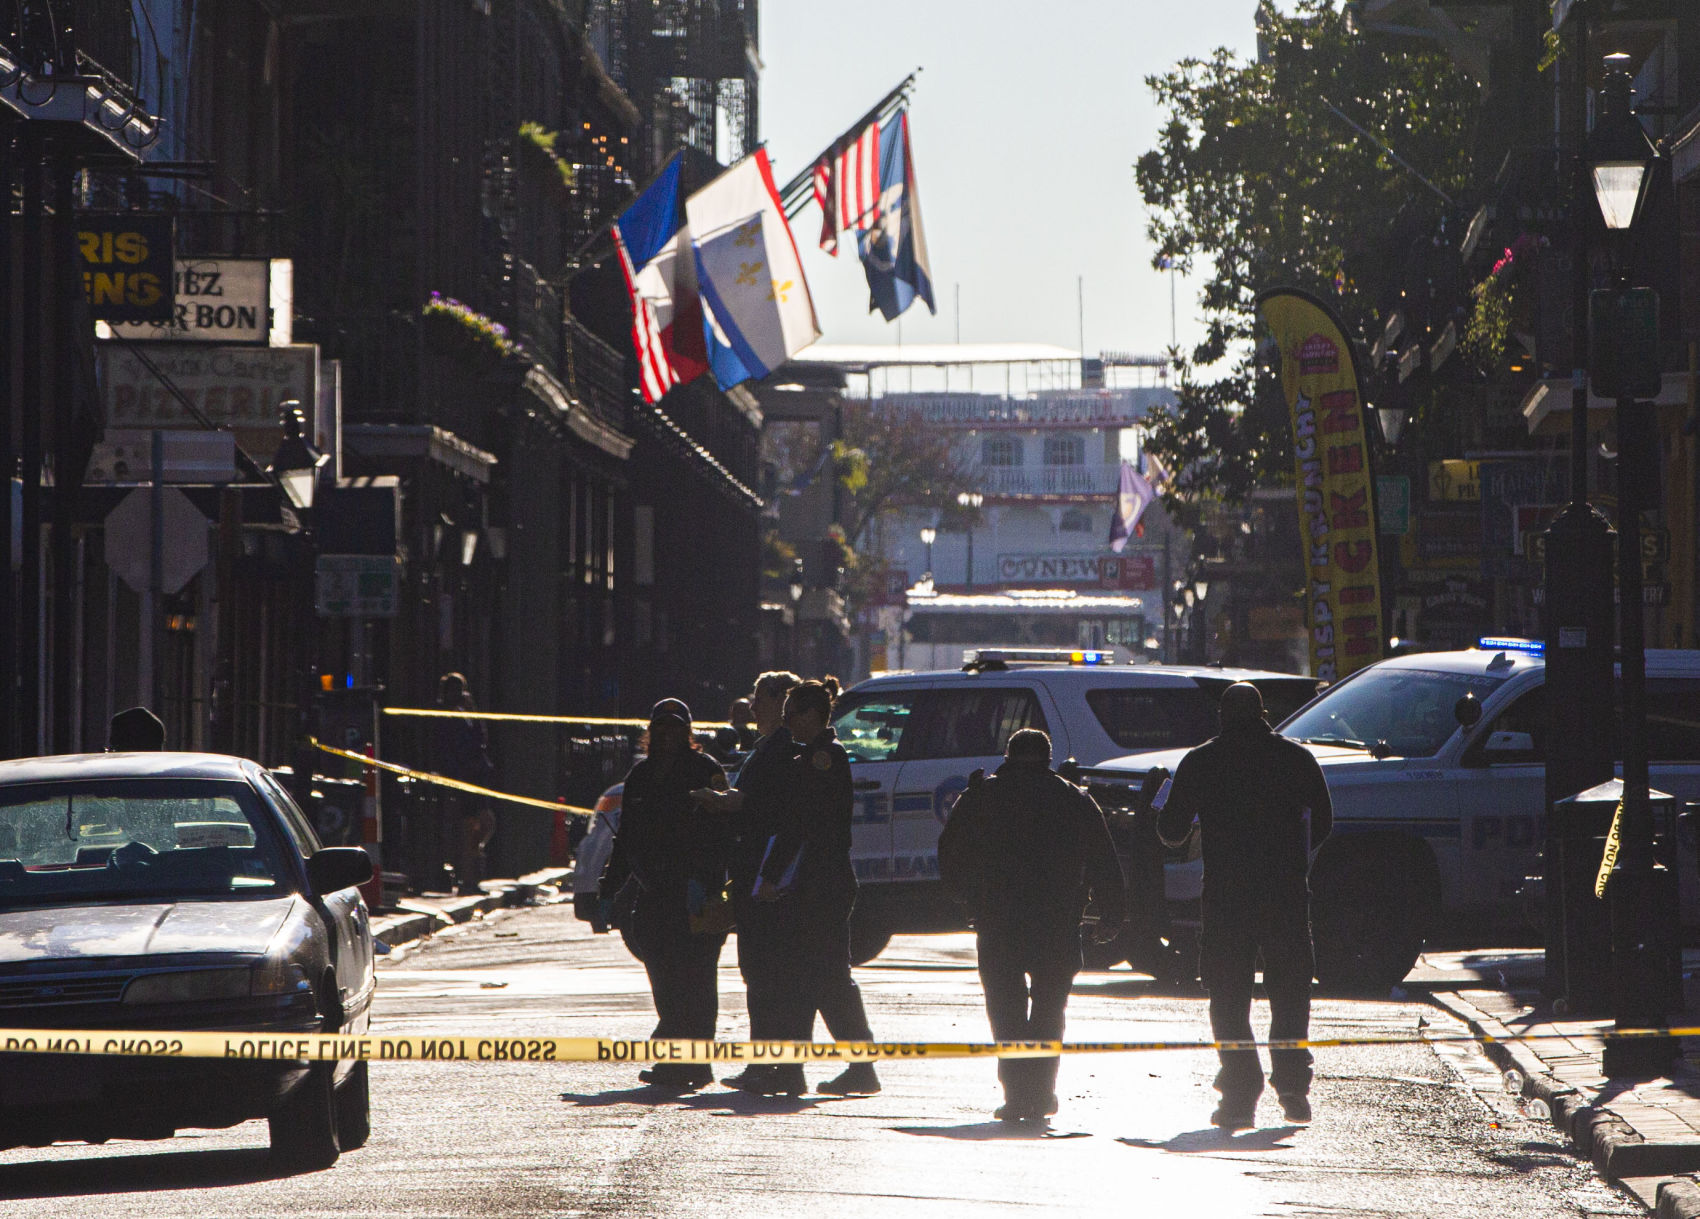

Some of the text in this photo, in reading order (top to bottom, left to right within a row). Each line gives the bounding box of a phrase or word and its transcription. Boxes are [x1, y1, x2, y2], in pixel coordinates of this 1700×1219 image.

[1293, 390, 1329, 567] KRUNCHY
[1320, 389, 1379, 657] HICKEN
[1311, 578, 1337, 681] RISPY
